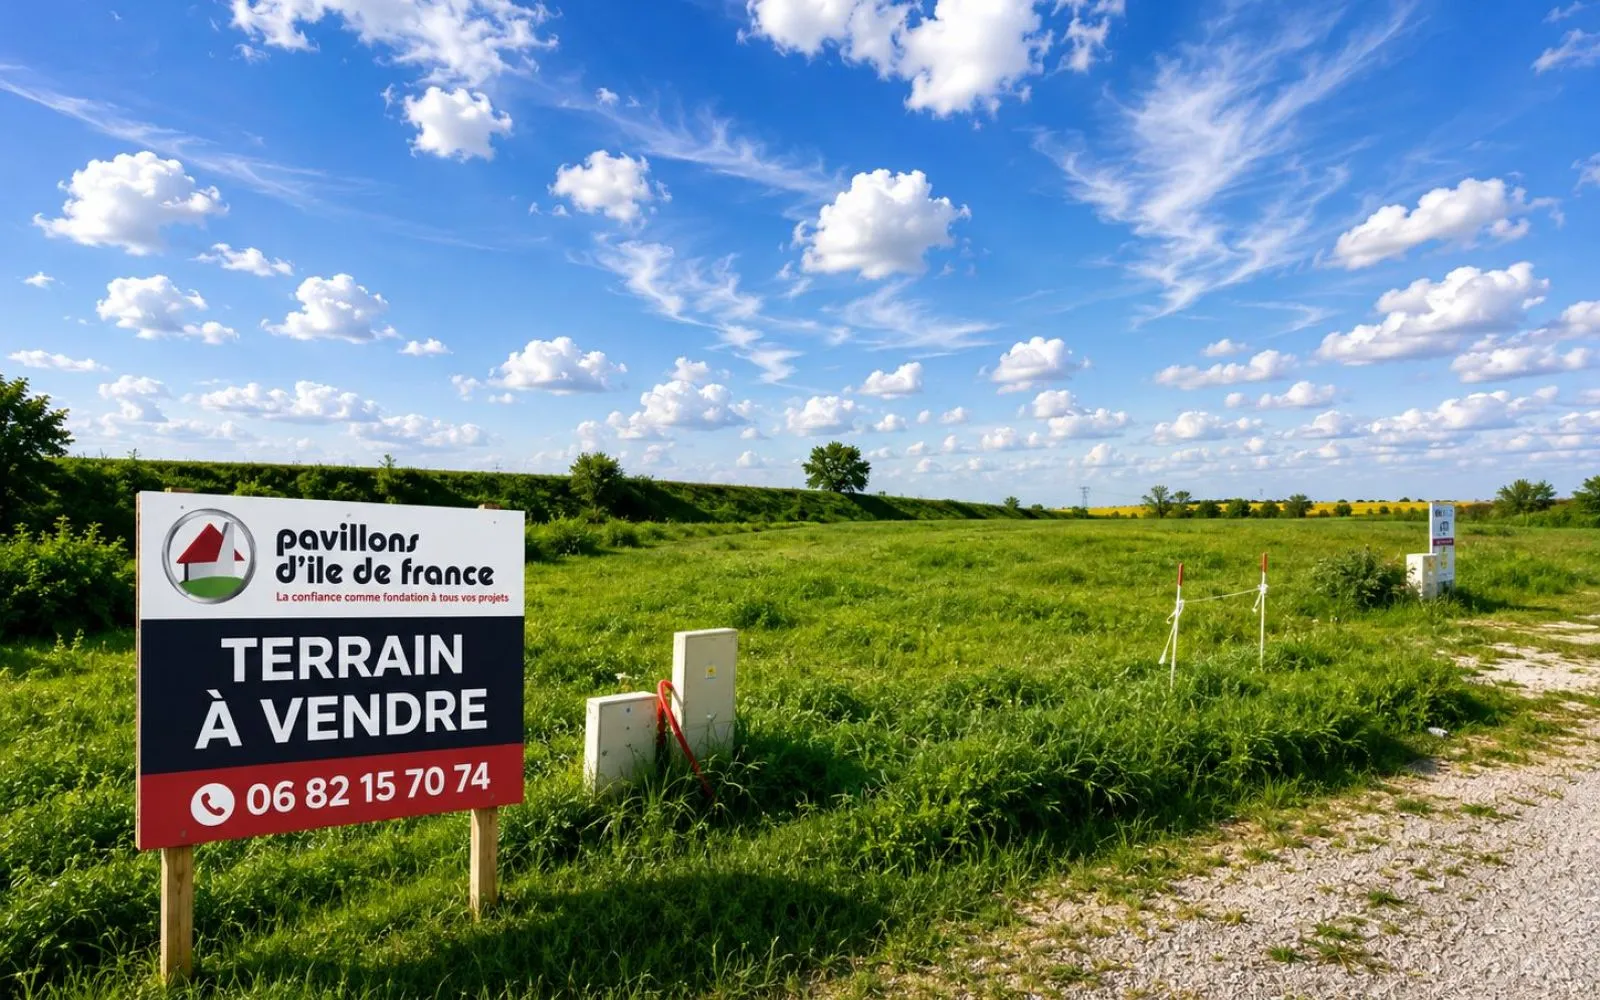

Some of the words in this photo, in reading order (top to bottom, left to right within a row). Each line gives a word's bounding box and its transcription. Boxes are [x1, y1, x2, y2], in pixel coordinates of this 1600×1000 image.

[276, 523, 419, 557] pavillons
[353, 557, 391, 585] de
[402, 558, 494, 586] france
[276, 592, 289, 602] La
[292, 592, 342, 602] confiance
[344, 594, 380, 602] comme
[383, 592, 429, 602] fondation
[431, 593, 437, 603] à
[439, 594, 459, 603] tous
[461, 595, 476, 603] vos
[478, 593, 509, 604] projets
[221, 635, 462, 682] TERRAIN
[195, 689, 242, 749] À
[260, 689, 487, 744] VENDRE
[247, 781, 295, 815] 06
[306, 776, 349, 809] 82
[360, 771, 395, 802] 15
[406, 767, 444, 798] 70
[454, 763, 491, 793] 74
